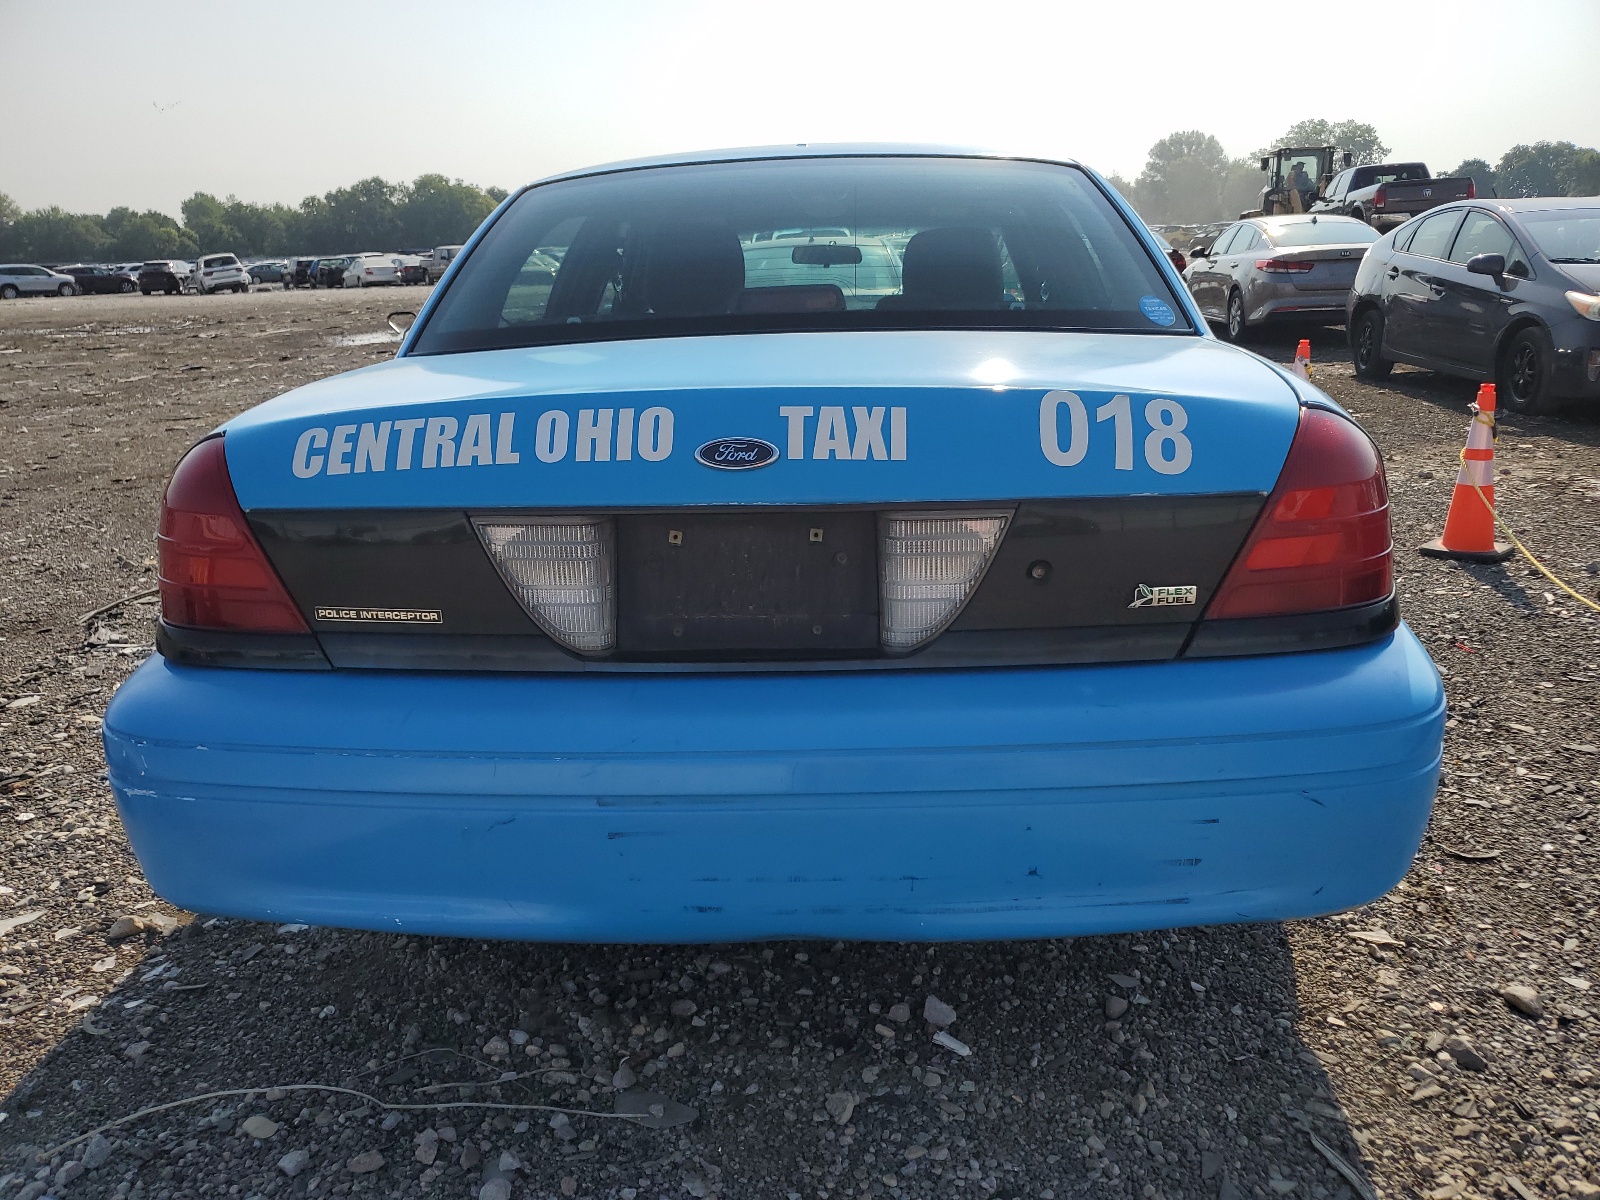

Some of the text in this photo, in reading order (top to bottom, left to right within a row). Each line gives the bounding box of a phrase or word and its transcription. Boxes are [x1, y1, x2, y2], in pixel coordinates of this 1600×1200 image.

[1039, 390, 1194, 475] 018
[292, 406, 908, 479] CENTRAL OHIO TAXI
[714, 443, 759, 461] Ford
[1158, 588, 1193, 596] FLEX
[318, 609, 438, 620] POLICE INTERCEPTOR
